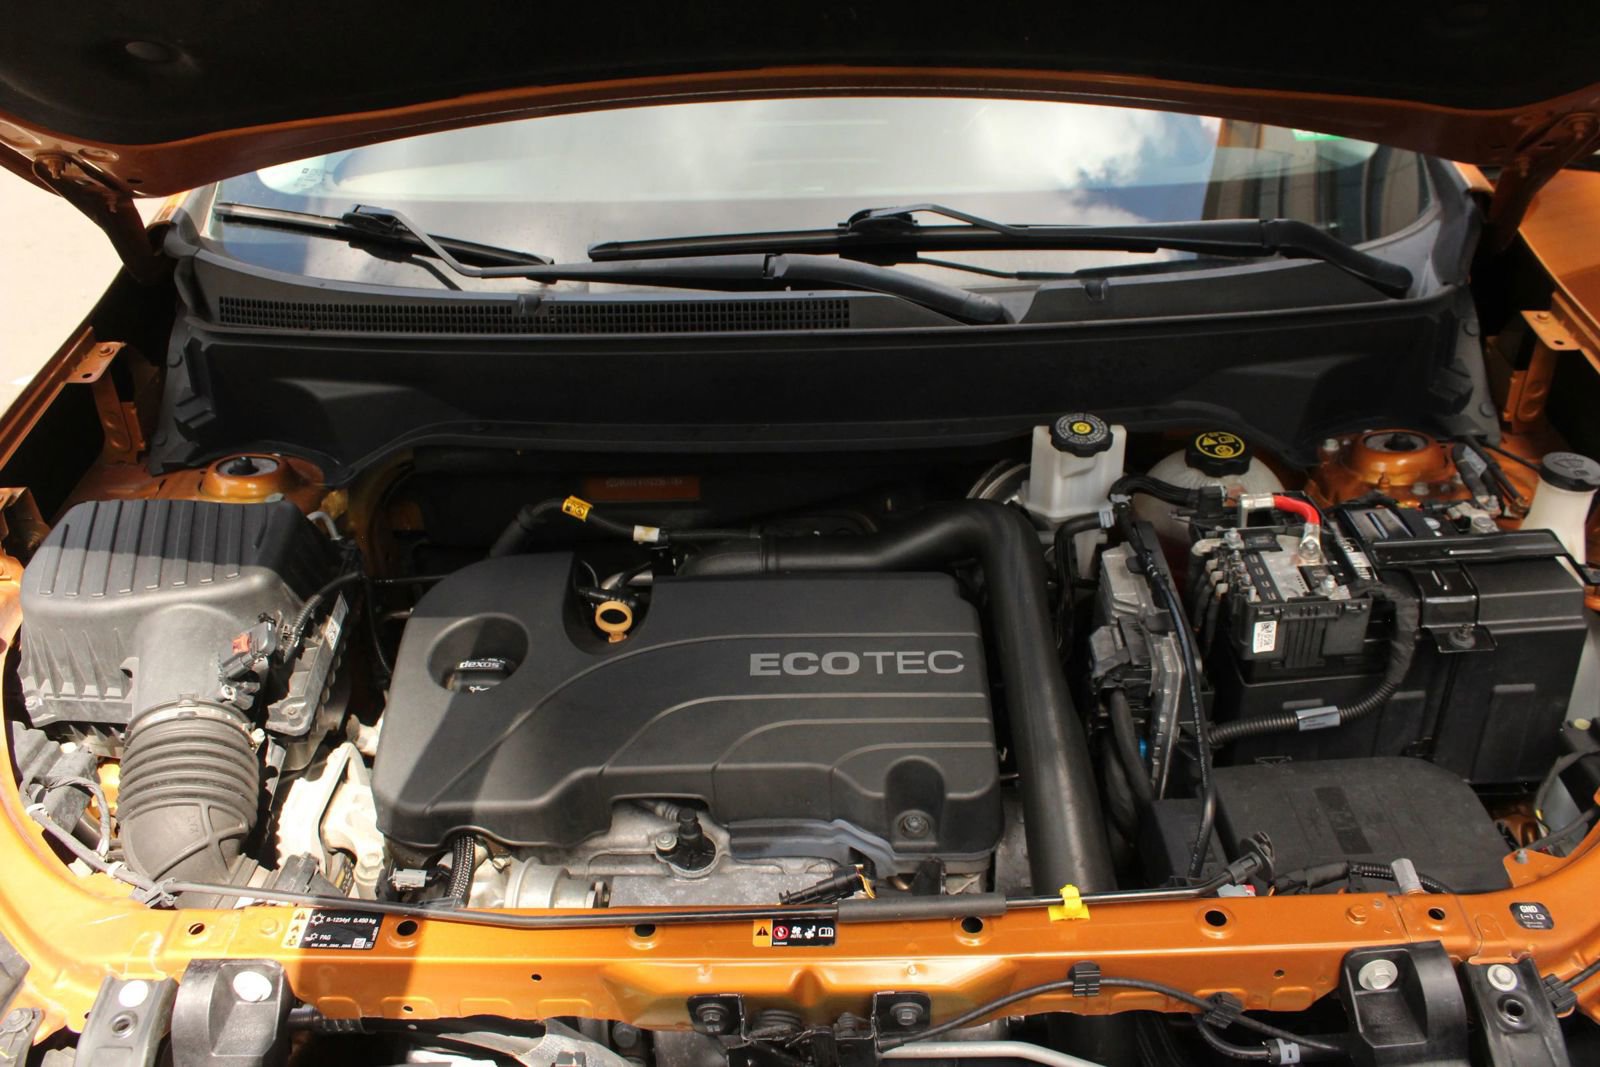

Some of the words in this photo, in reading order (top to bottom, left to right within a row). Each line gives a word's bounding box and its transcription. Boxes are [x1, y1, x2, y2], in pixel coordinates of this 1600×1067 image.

[459, 660, 500, 668] dexos
[749, 650, 965, 676] ECOTEC
[1519, 905, 1538, 913] GND
